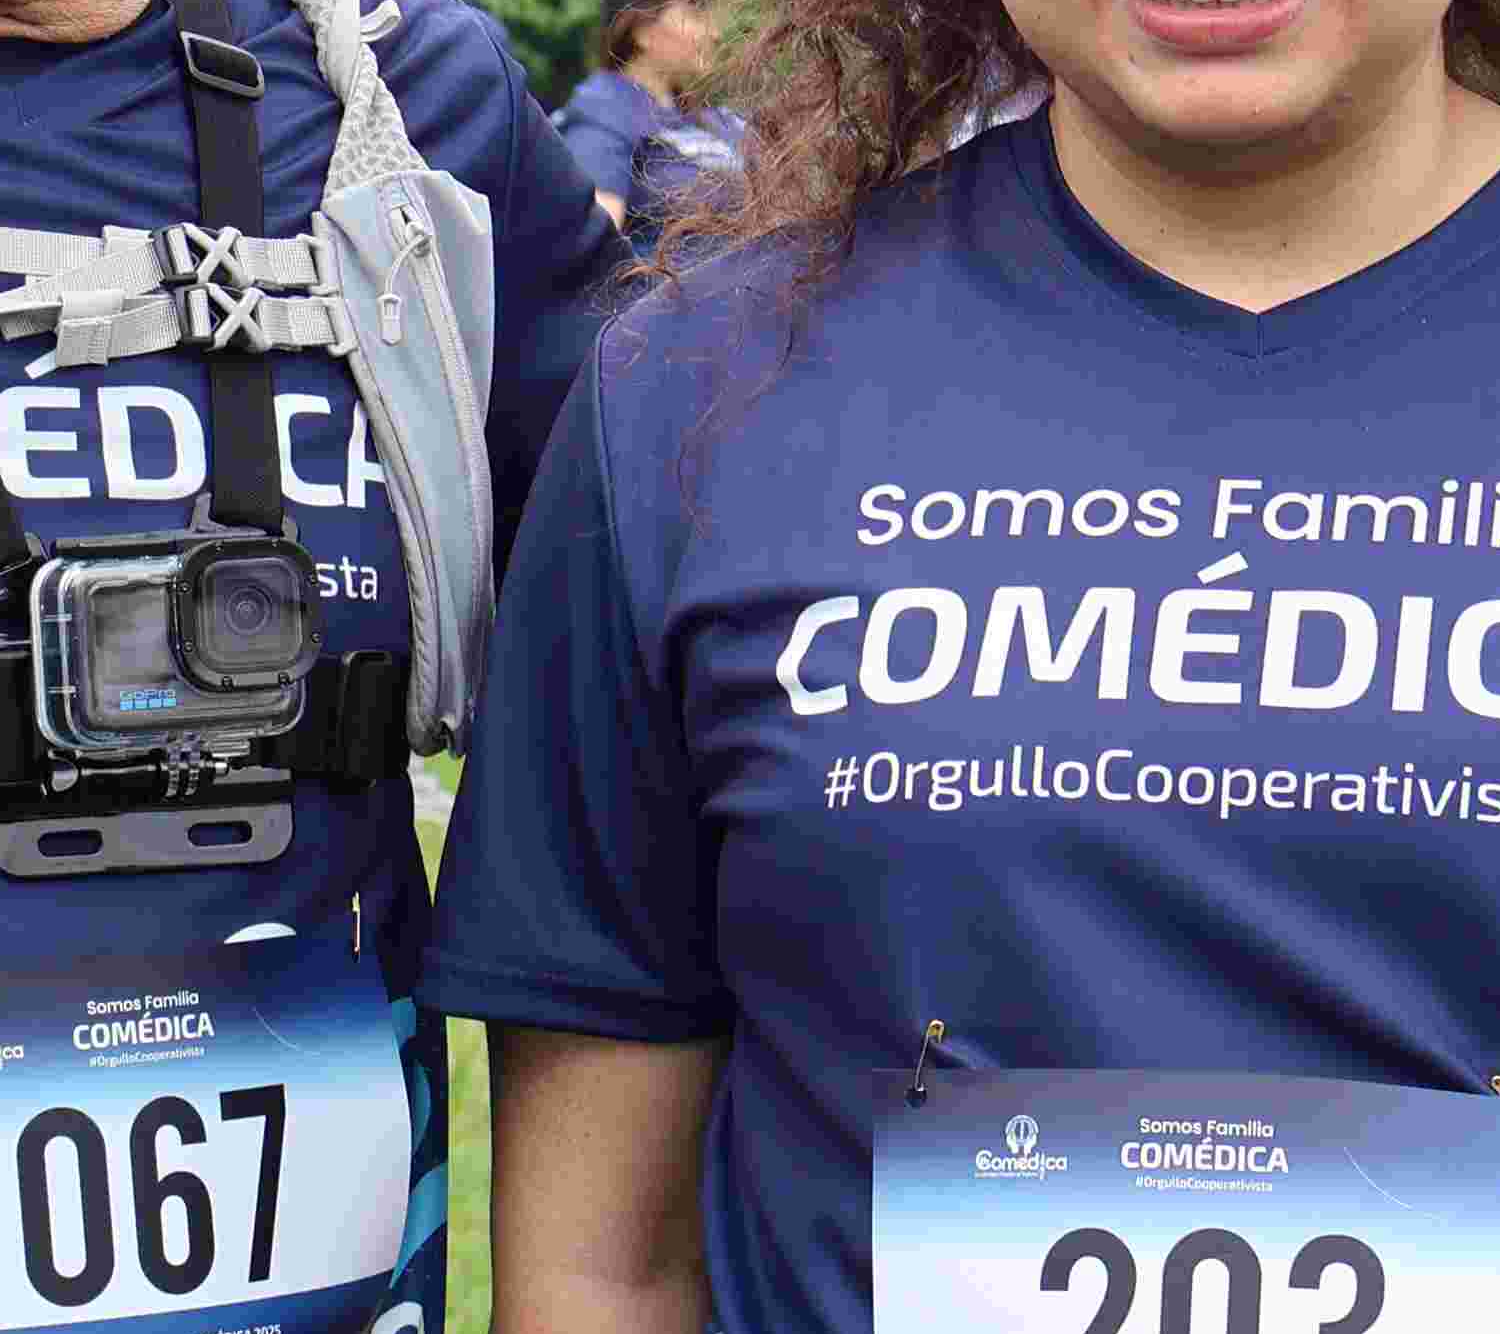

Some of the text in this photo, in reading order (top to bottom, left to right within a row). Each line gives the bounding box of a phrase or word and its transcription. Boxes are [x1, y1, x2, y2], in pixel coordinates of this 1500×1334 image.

[855, 482, 1181, 546] Somos
[86, 988, 200, 1016] Somos Familia
[71, 1011, 215, 1051] COMÉDICA
[1139, 1117, 1275, 1139] Somos Familia
[1119, 1138, 1289, 1174] COMÉDICA
[15, 1082, 287, 1309] 067
